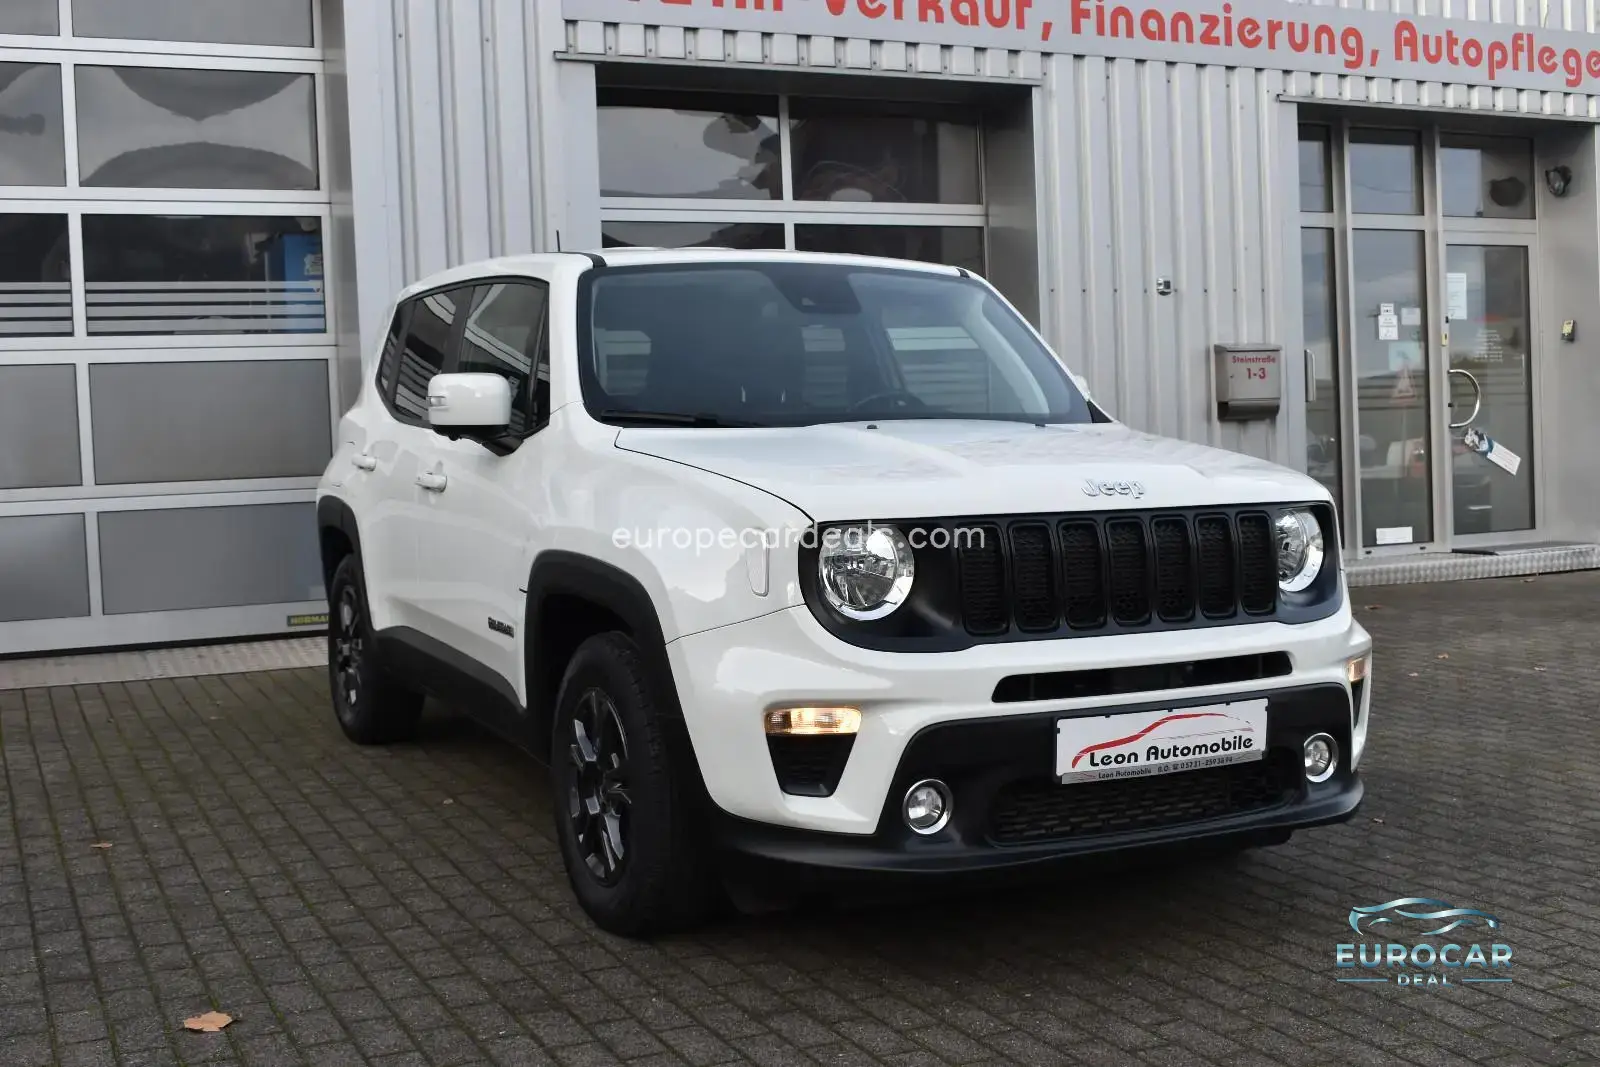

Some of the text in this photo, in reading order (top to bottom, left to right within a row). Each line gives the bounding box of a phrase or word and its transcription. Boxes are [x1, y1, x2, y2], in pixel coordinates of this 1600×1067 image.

[1071, 0, 1380, 69] Finanzierung,
[1394, 20, 1600, 87] Autopflege
[1231, 355, 1276, 364] Steinstraße
[1081, 479, 1145, 499] Jeep
[1089, 735, 1253, 767] Leon Automobile
